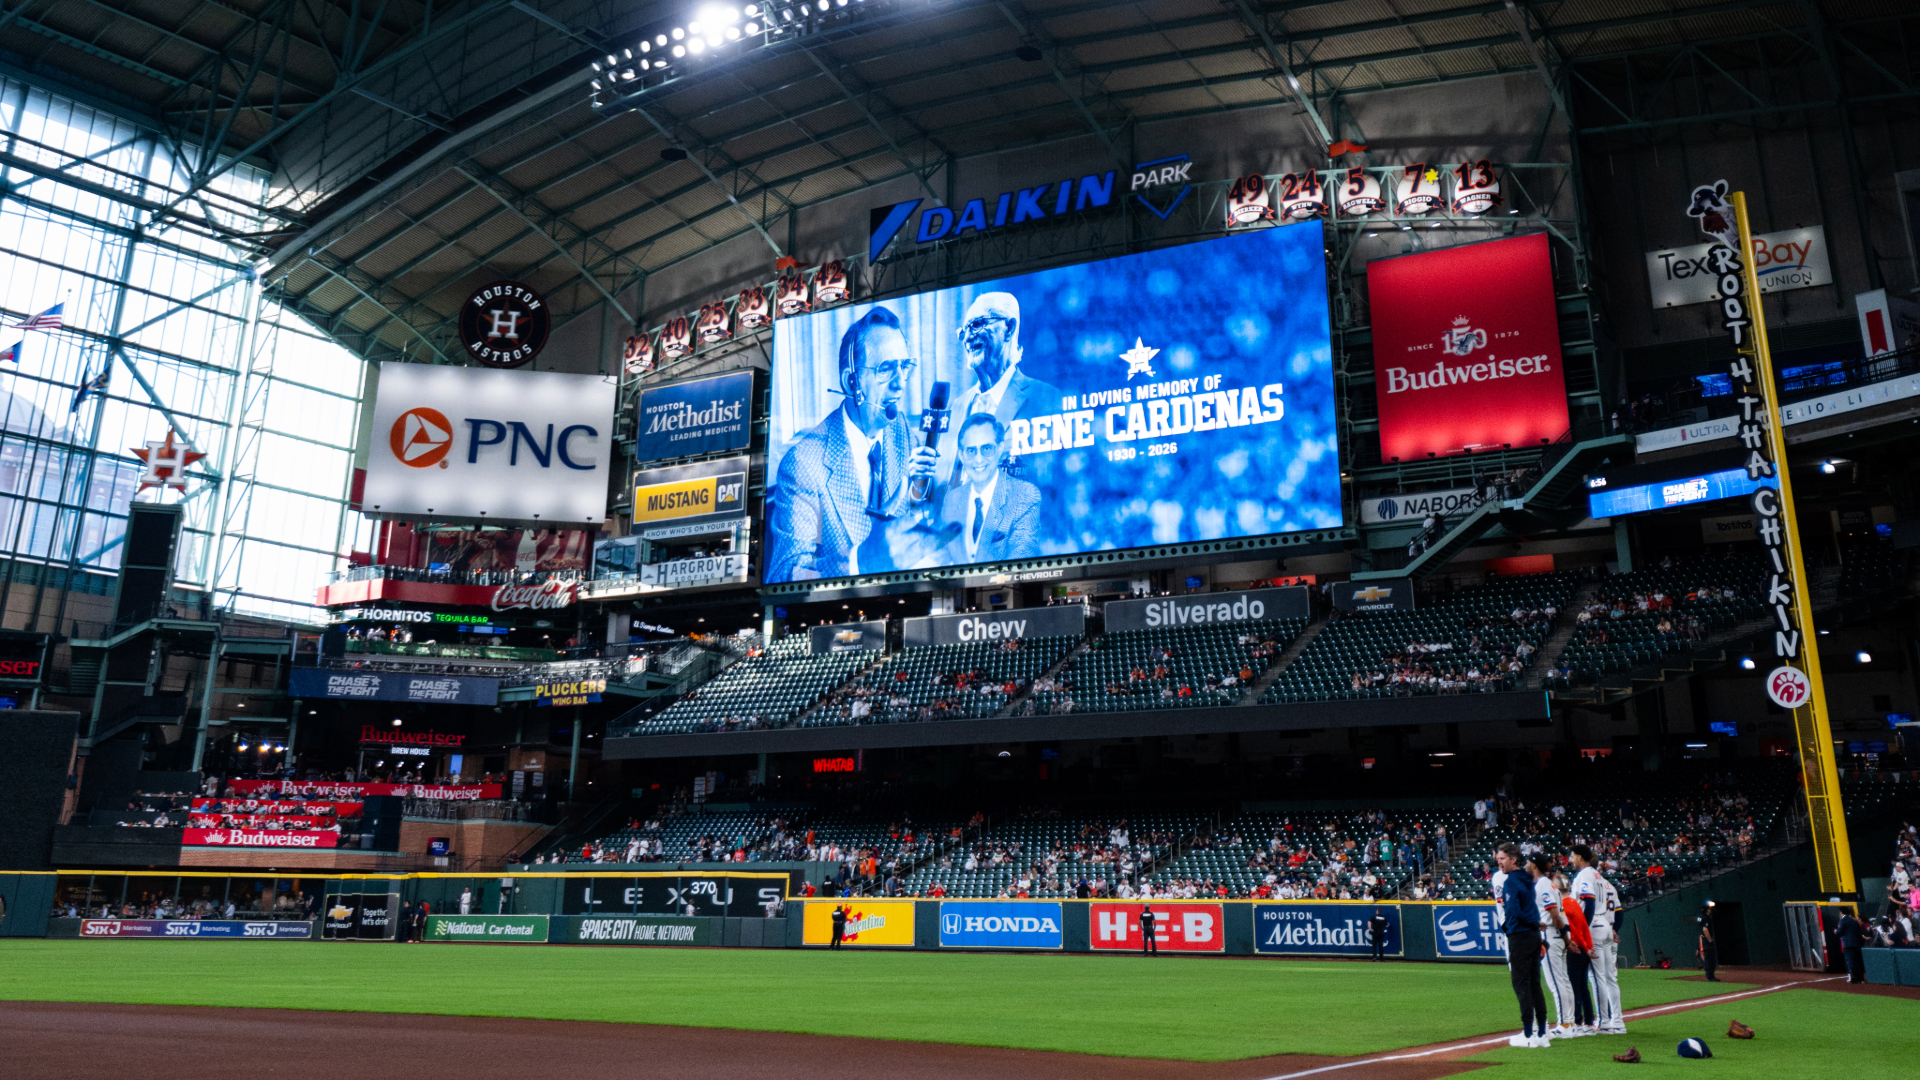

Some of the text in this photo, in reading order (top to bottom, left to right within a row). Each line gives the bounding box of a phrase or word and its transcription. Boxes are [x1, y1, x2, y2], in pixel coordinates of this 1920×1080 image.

[1131, 162, 1193, 191] PARK
[1281, 168, 1320, 202] 24
[1347, 167, 1364, 196] 5
[1404, 163, 1425, 194] 7
[1455, 159, 1495, 192] 13
[1228, 173, 1266, 205] 49
[1459, 194, 1492, 205] WAGNER
[916, 170, 1117, 244] DAIKIN
[1291, 201, 1314, 210] WYNN
[1342, 198, 1377, 211] BAGWELL
[1404, 196, 1433, 205] BIGGIO
[1752, 238, 1813, 271] Bay
[815, 259, 843, 287] 42
[1658, 252, 1713, 280] Tex
[776, 271, 805, 299] 34
[1766, 271, 1813, 288] UNION
[473, 285, 542, 310] HOUSTON
[737, 286, 764, 313] 33
[1713, 248, 1748, 344] ROOT
[697, 301, 726, 329] 25
[660, 316, 688, 343] 40
[471, 341, 533, 362] ASTROS
[624, 332, 650, 360] 32
[1407, 325, 1520, 357] SINCE 150 1876
[1385, 353, 1549, 394] Budweiser
[1731, 357, 1753, 384] 4
[1062, 374, 1222, 411] IN LOVING MEMORY OF
[645, 399, 743, 435] Methodist
[646, 401, 685, 414] HOUSTON
[1010, 383, 1284, 456] RENE CARDENAS
[670, 424, 741, 442] LEADING MEDICINE
[1689, 422, 1730, 439] ULTRA
[1738, 397, 1772, 477] THA
[464, 418, 599, 471] PNC
[1107, 448, 1136, 461] 1930
[1148, 442, 1178, 458] 2026
[718, 482, 743, 503] CAT
[1591, 478, 1607, 488] 6:56
[648, 488, 709, 512] MUSTANG
[1403, 493, 1486, 515] NABORS
[646, 519, 747, 538] KNOW WHO'S ON YOUR ROOF
[657, 557, 734, 584] HARGROVE
[674, 572, 715, 582] ROOFING
[1013, 569, 1064, 582] CHEVROLET
[1755, 491, 1799, 657] CHIKIN
[362, 608, 433, 623] HORNITOS
[1145, 595, 1265, 627] Silverado
[1356, 603, 1394, 611] HEVROLET
[435, 613, 488, 624] TEQUILA BAR
[957, 617, 1027, 642] Chevy
[328, 675, 370, 687] CHASE
[328, 686, 380, 697] THE FIGHT
[409, 679, 450, 691] CHASE
[535, 679, 607, 698] PLUCKERS
[409, 689, 460, 700] THE FIGHT
[552, 696, 572, 706] WING
[359, 724, 466, 746] Budweiser
[391, 747, 430, 756] BREW HOUSE
[813, 758, 854, 773] WHATAB
[281, 780, 364, 796] Budweiser
[413, 784, 482, 799] Budweiser
[229, 830, 319, 846] Budweiser
[691, 882, 716, 894] 370
[965, 917, 1059, 934] HONDA
[1263, 911, 1312, 921] HOUSTON
[279, 926, 307, 934] Marketing
[447, 920, 534, 936] National Car Rental
[579, 919, 697, 941] SPACE CITY HOME NETWORK
[1099, 912, 1214, 942] H-E-B
